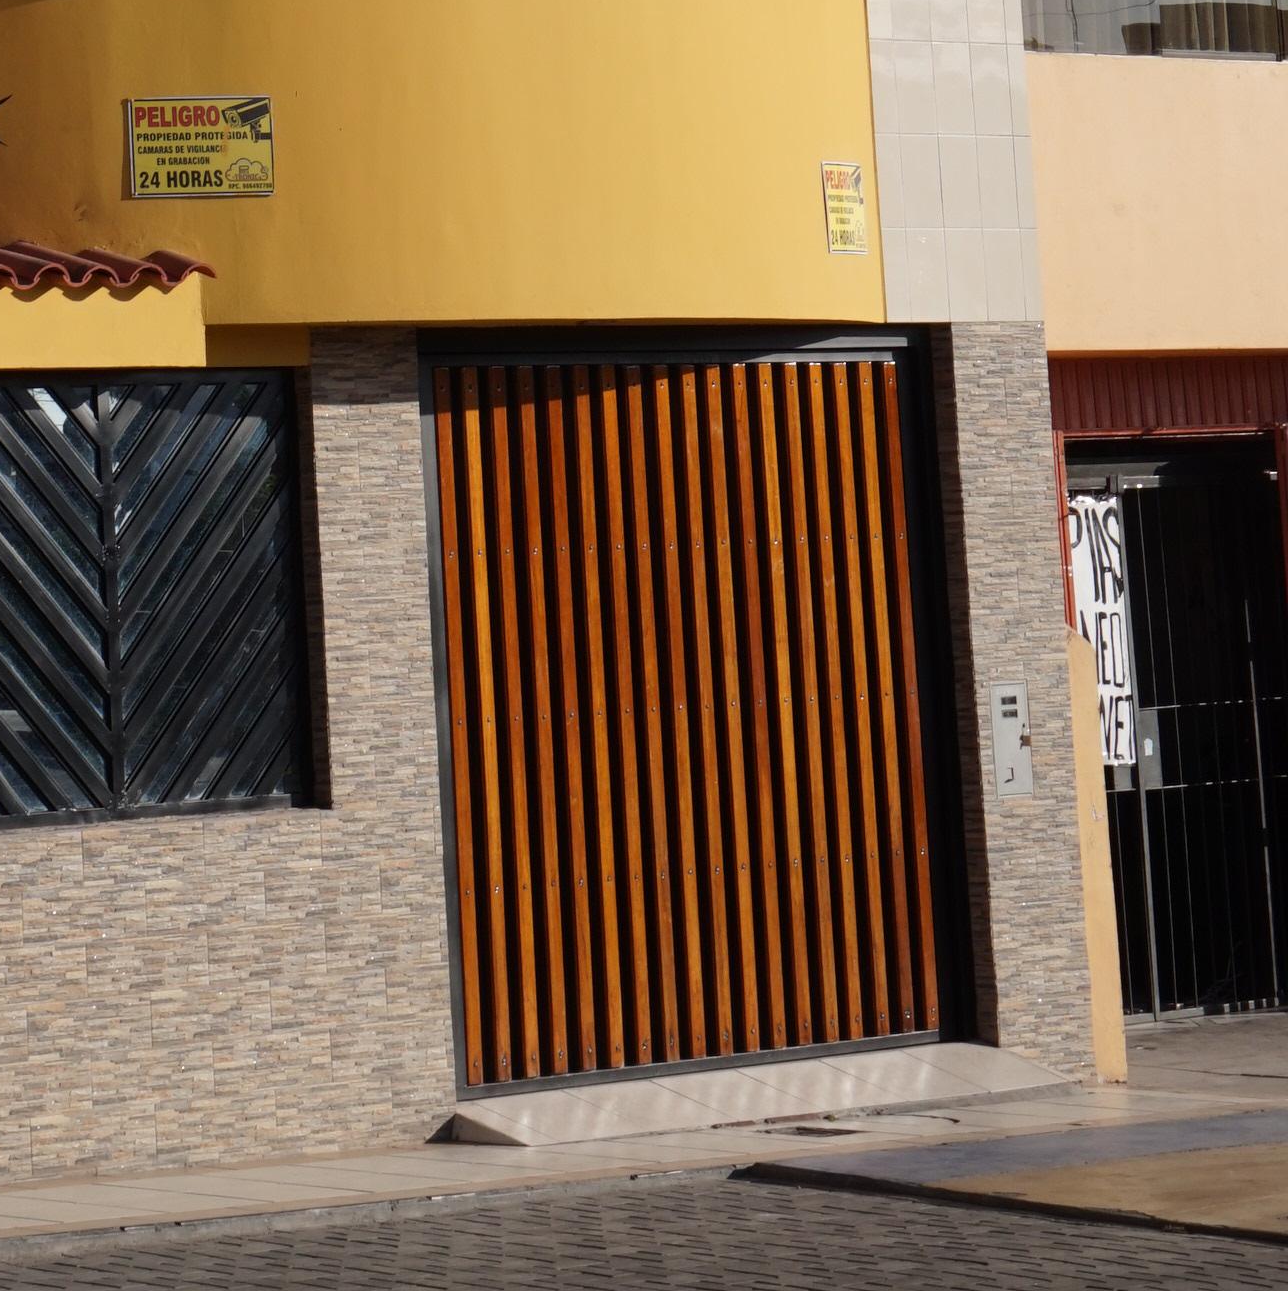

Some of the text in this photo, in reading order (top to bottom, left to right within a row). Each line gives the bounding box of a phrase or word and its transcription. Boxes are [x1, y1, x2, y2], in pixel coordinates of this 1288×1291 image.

[134, 105, 220, 128] PELIGRO
[136, 131, 192, 142] PROPIEDAD
[137, 145, 174, 155] CAMARAS
[175, 145, 185, 154] DE
[156, 157, 167, 166] EN
[139, 171, 161, 189] 24
[166, 169, 224, 188] HORAS
